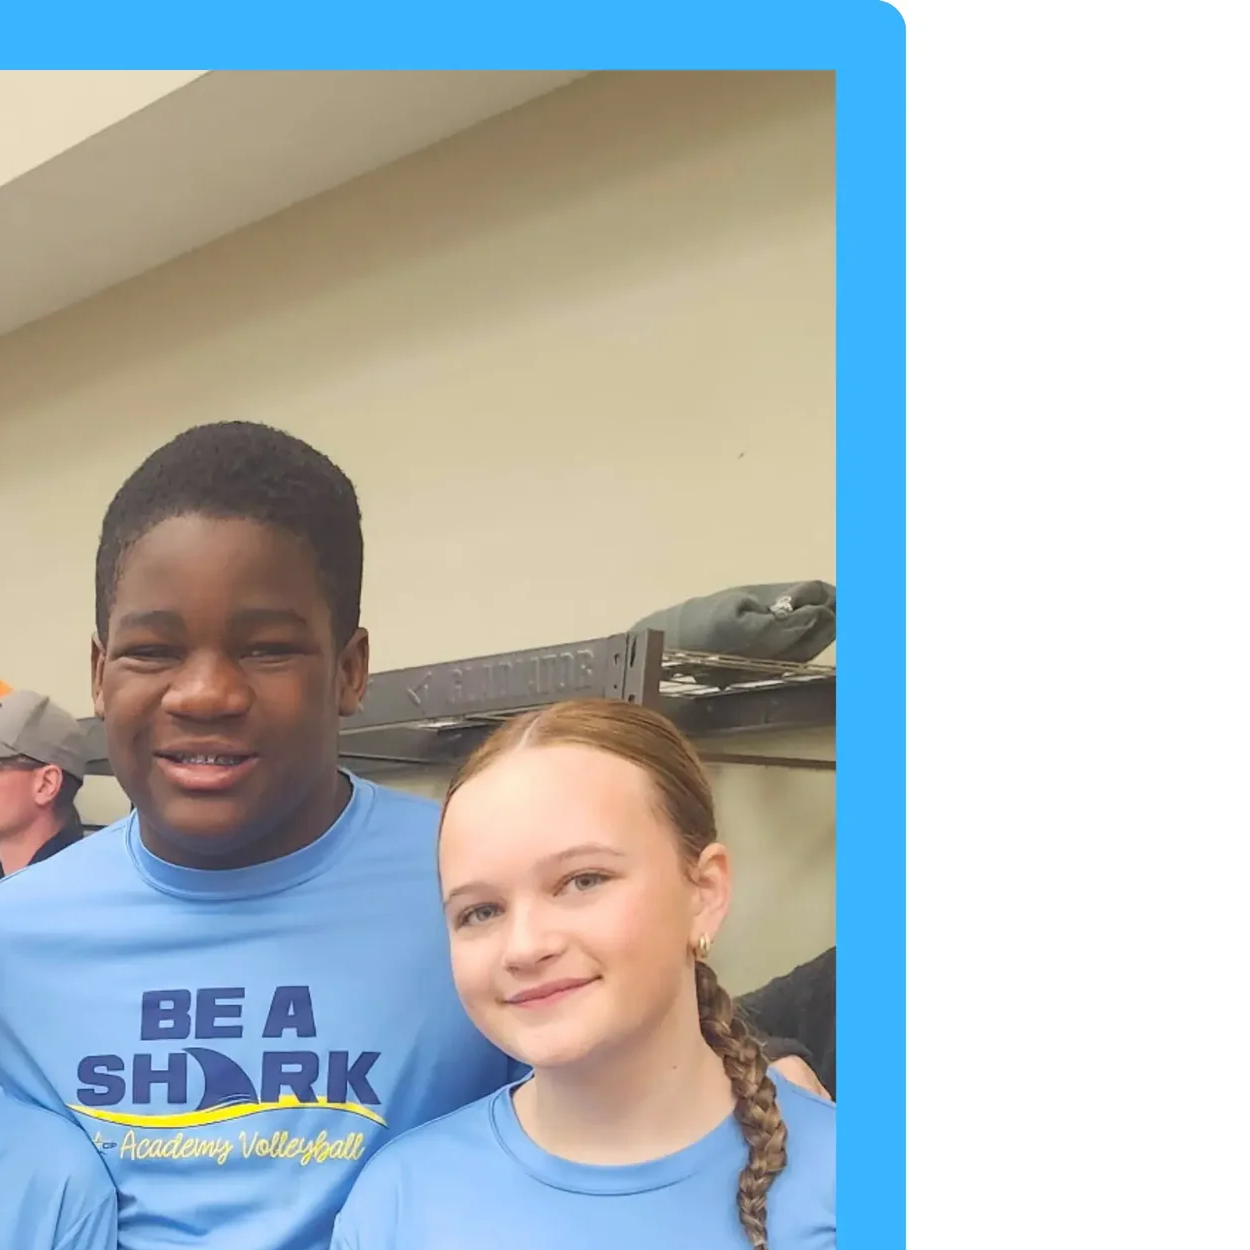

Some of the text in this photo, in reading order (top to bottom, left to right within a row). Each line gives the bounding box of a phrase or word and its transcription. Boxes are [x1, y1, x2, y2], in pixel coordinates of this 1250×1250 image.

[140, 985, 317, 1041] BE A
[118, 1129, 365, 1166] Academy Volleyball
